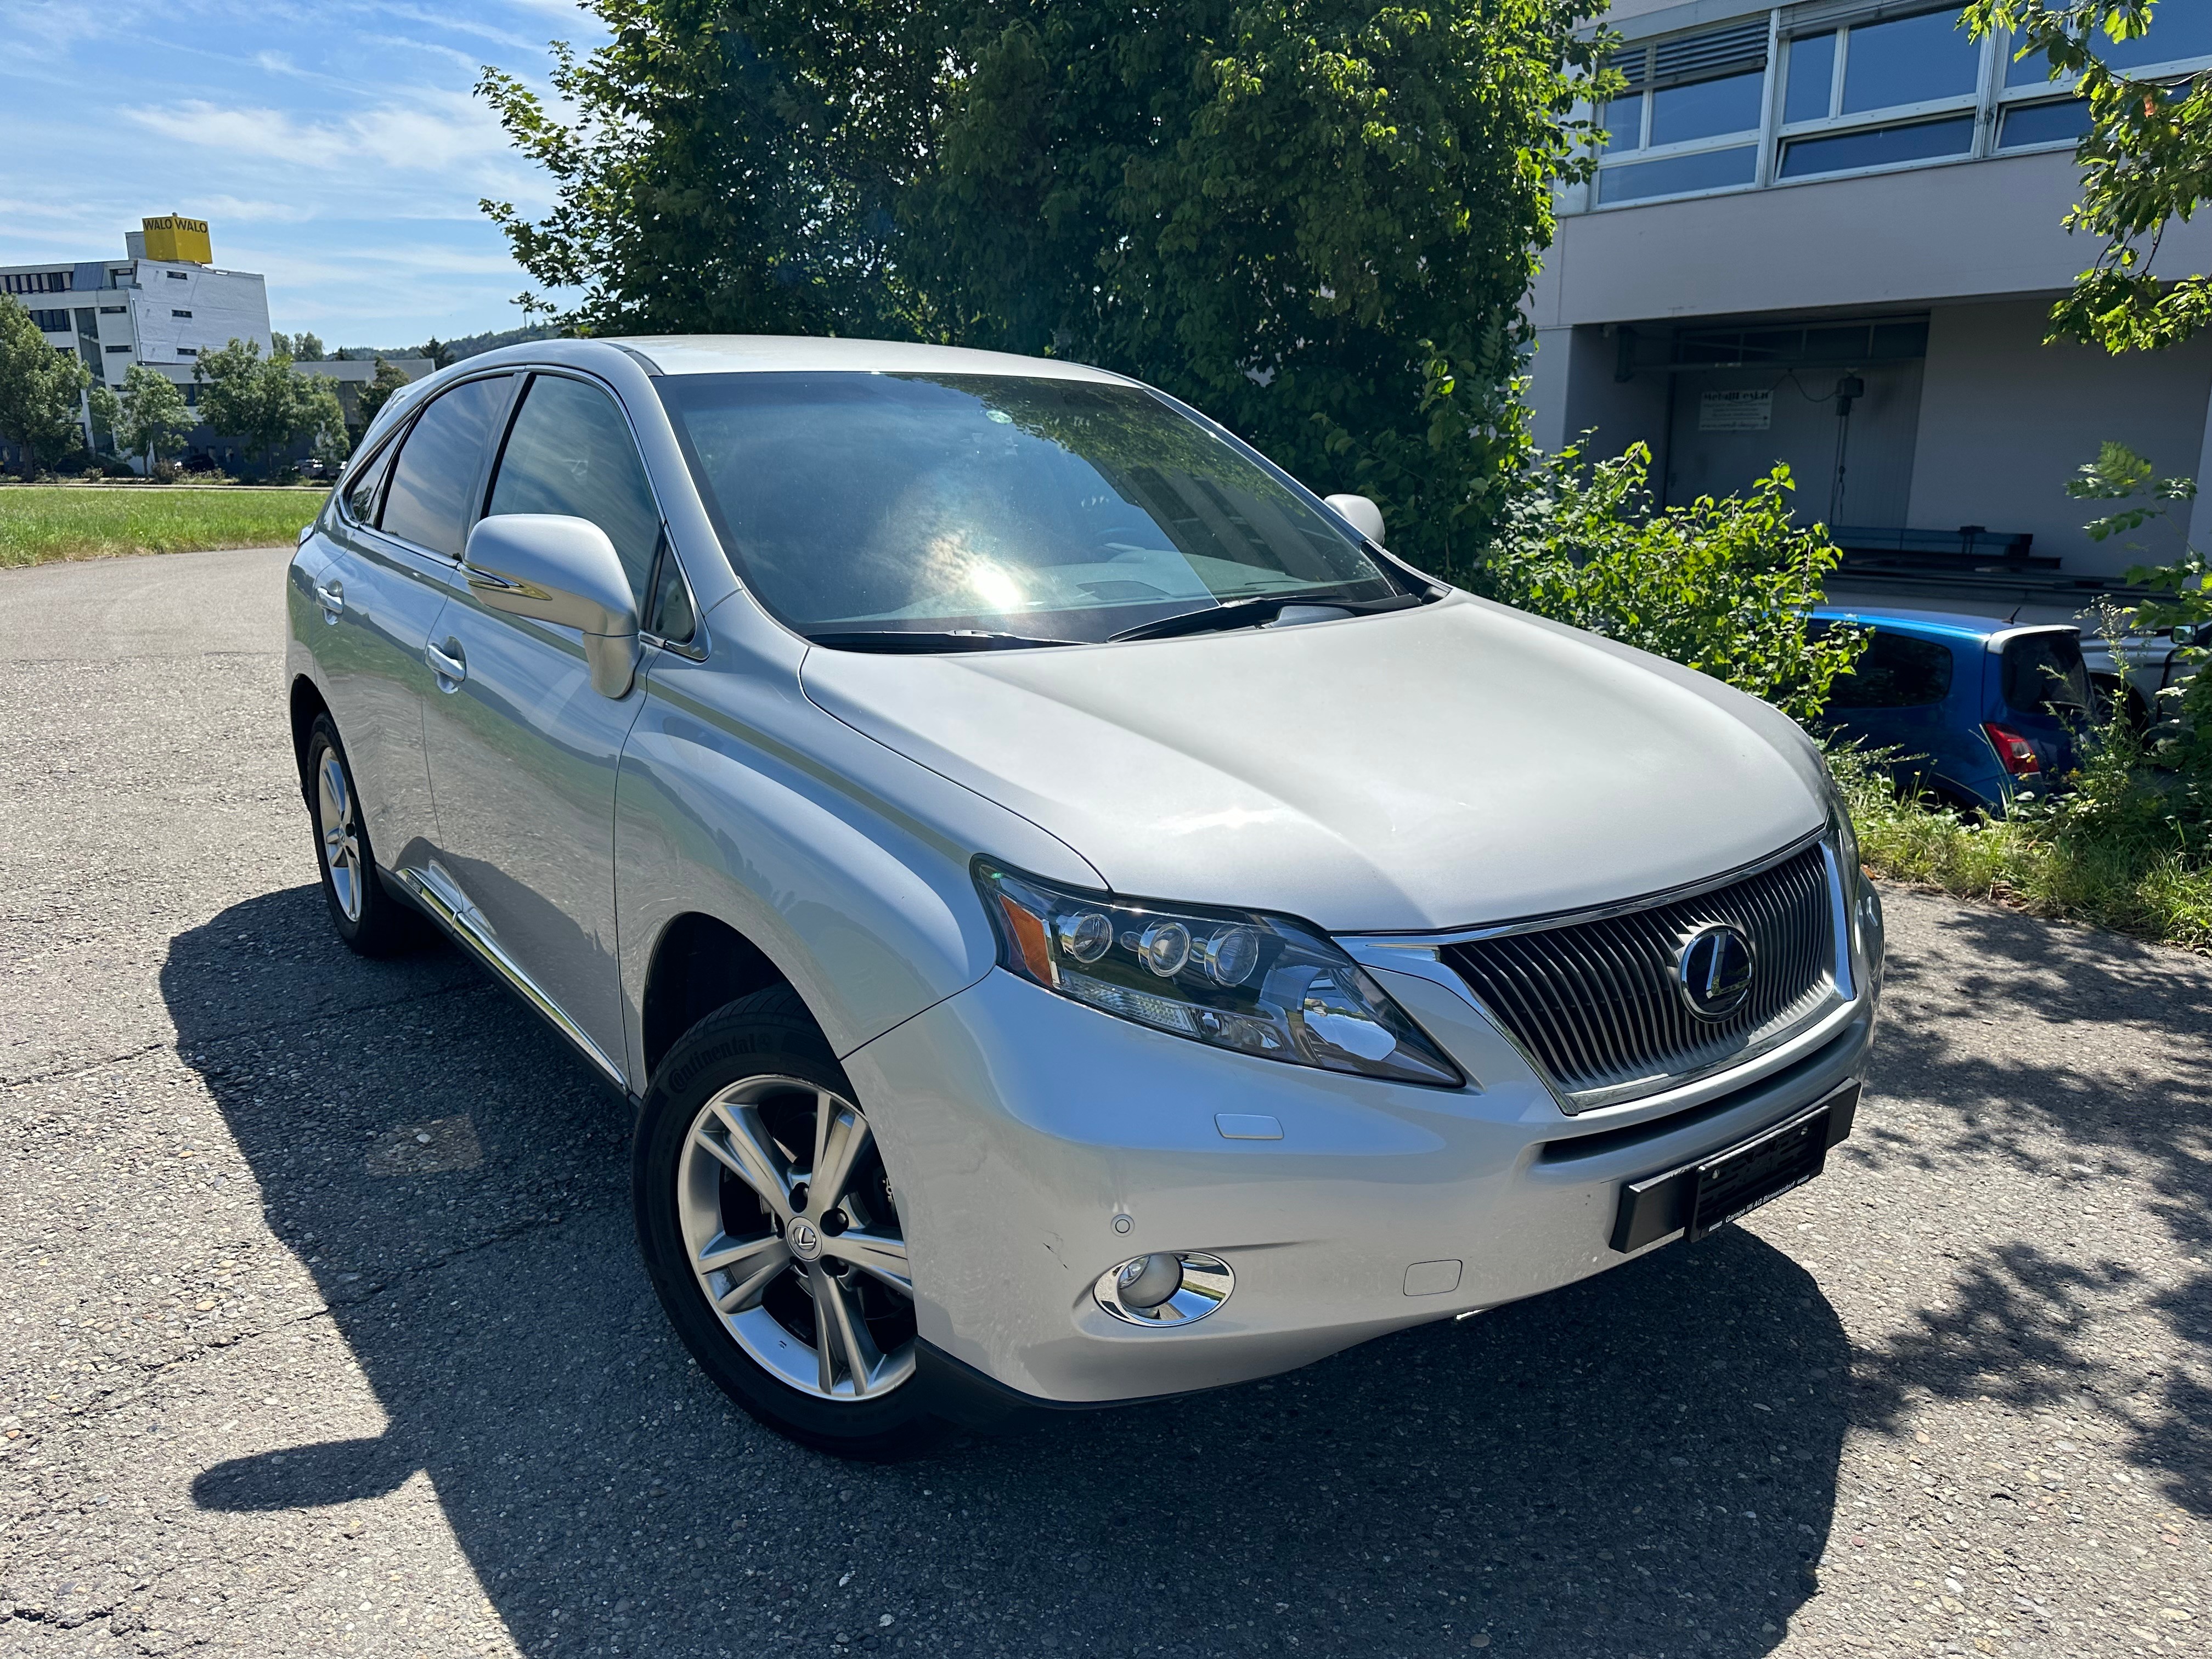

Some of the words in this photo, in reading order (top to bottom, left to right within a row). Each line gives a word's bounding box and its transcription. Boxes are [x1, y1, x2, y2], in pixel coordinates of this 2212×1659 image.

[143, 219, 172, 230] WALO
[174, 219, 207, 233] WALO
[668, 1033, 757, 1093] Continental
[1725, 1208, 1746, 1223] Garage
[1753, 1198, 1763, 1209] AG
[1763, 1181, 1795, 1203] Birmensdorf
